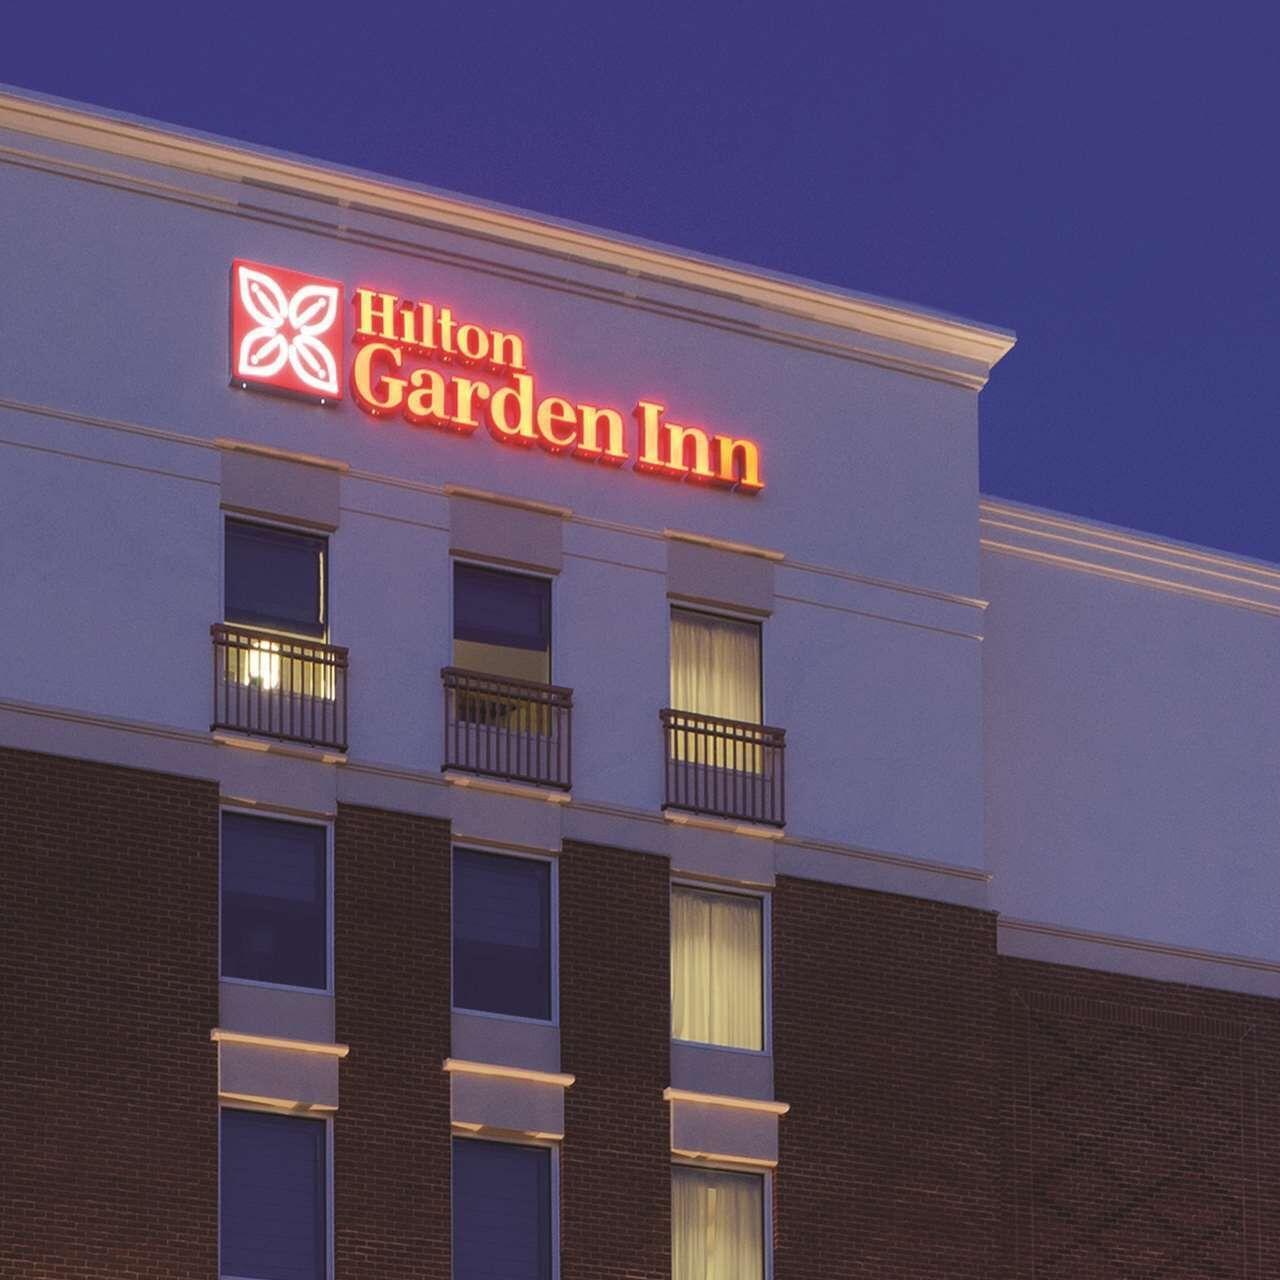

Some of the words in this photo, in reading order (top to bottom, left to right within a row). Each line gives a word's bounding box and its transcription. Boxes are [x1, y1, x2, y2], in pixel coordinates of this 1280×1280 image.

[356, 287, 527, 370] Hilton
[353, 343, 628, 459] Garden
[637, 401, 764, 490] Inn
